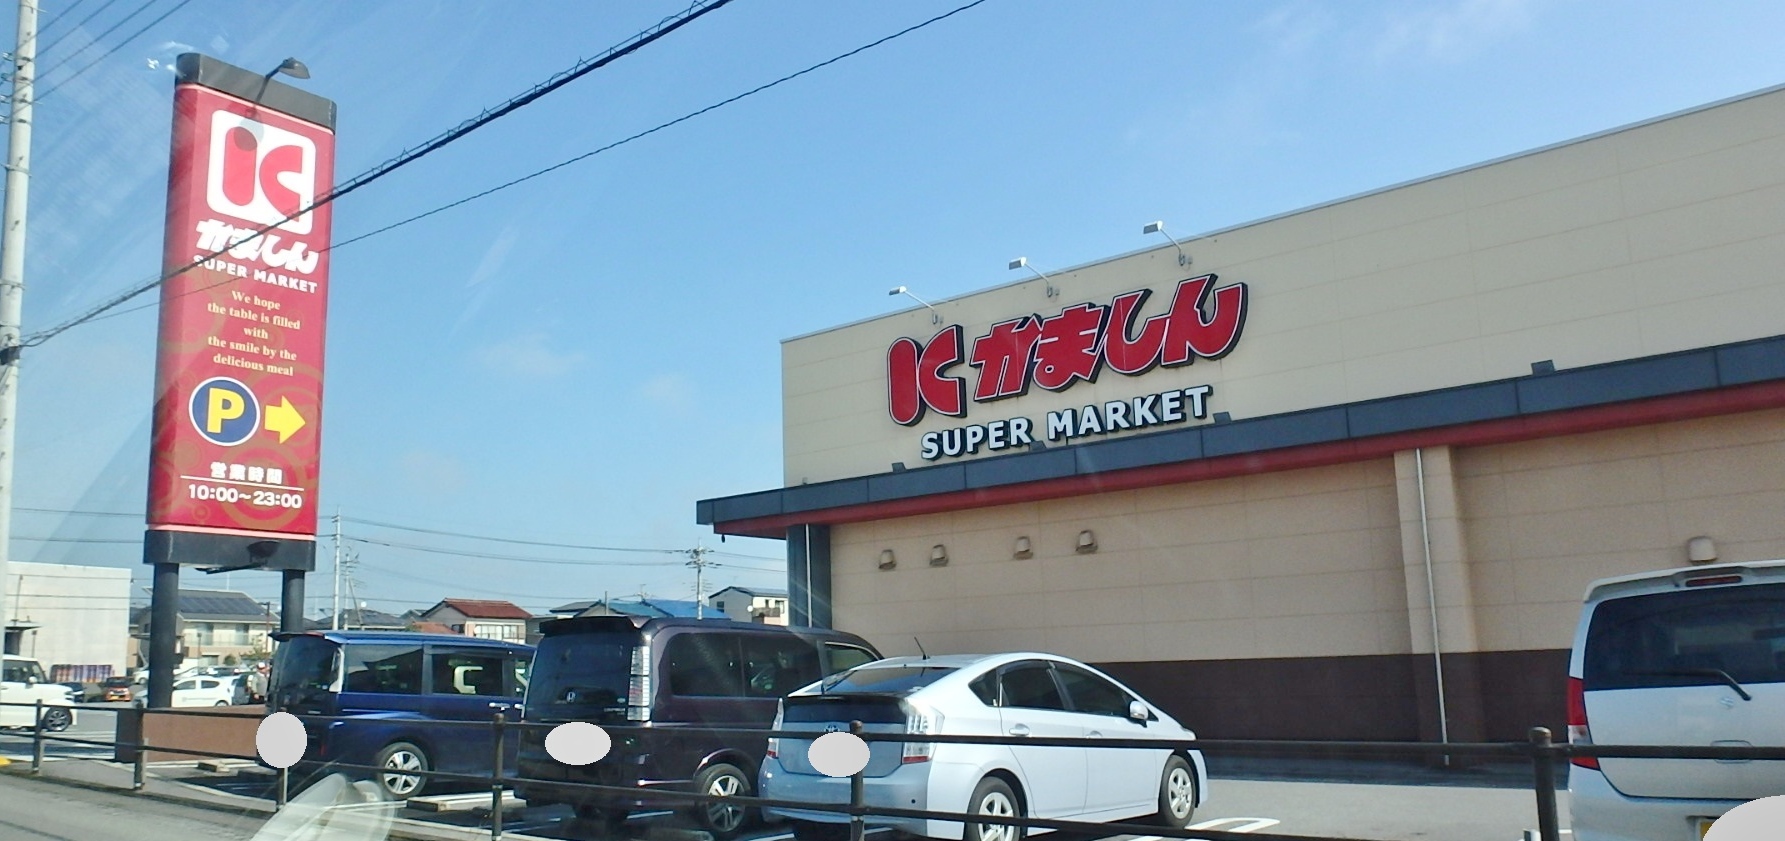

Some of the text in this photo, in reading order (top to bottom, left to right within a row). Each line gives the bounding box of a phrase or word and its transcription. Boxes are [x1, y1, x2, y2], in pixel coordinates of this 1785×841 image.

[193, 254, 318, 294] SUPER MARKET
[231, 290, 281, 311] We hope
[207, 302, 301, 330] the table is filled
[243, 327, 269, 340] with
[969, 273, 1249, 403] かましん
[207, 335, 297, 361] the smile by the
[213, 353, 294, 377] delicious meal
[207, 387, 245, 434] P
[920, 384, 1214, 461] SUPER MARKET
[210, 461, 283, 485] 営業時間
